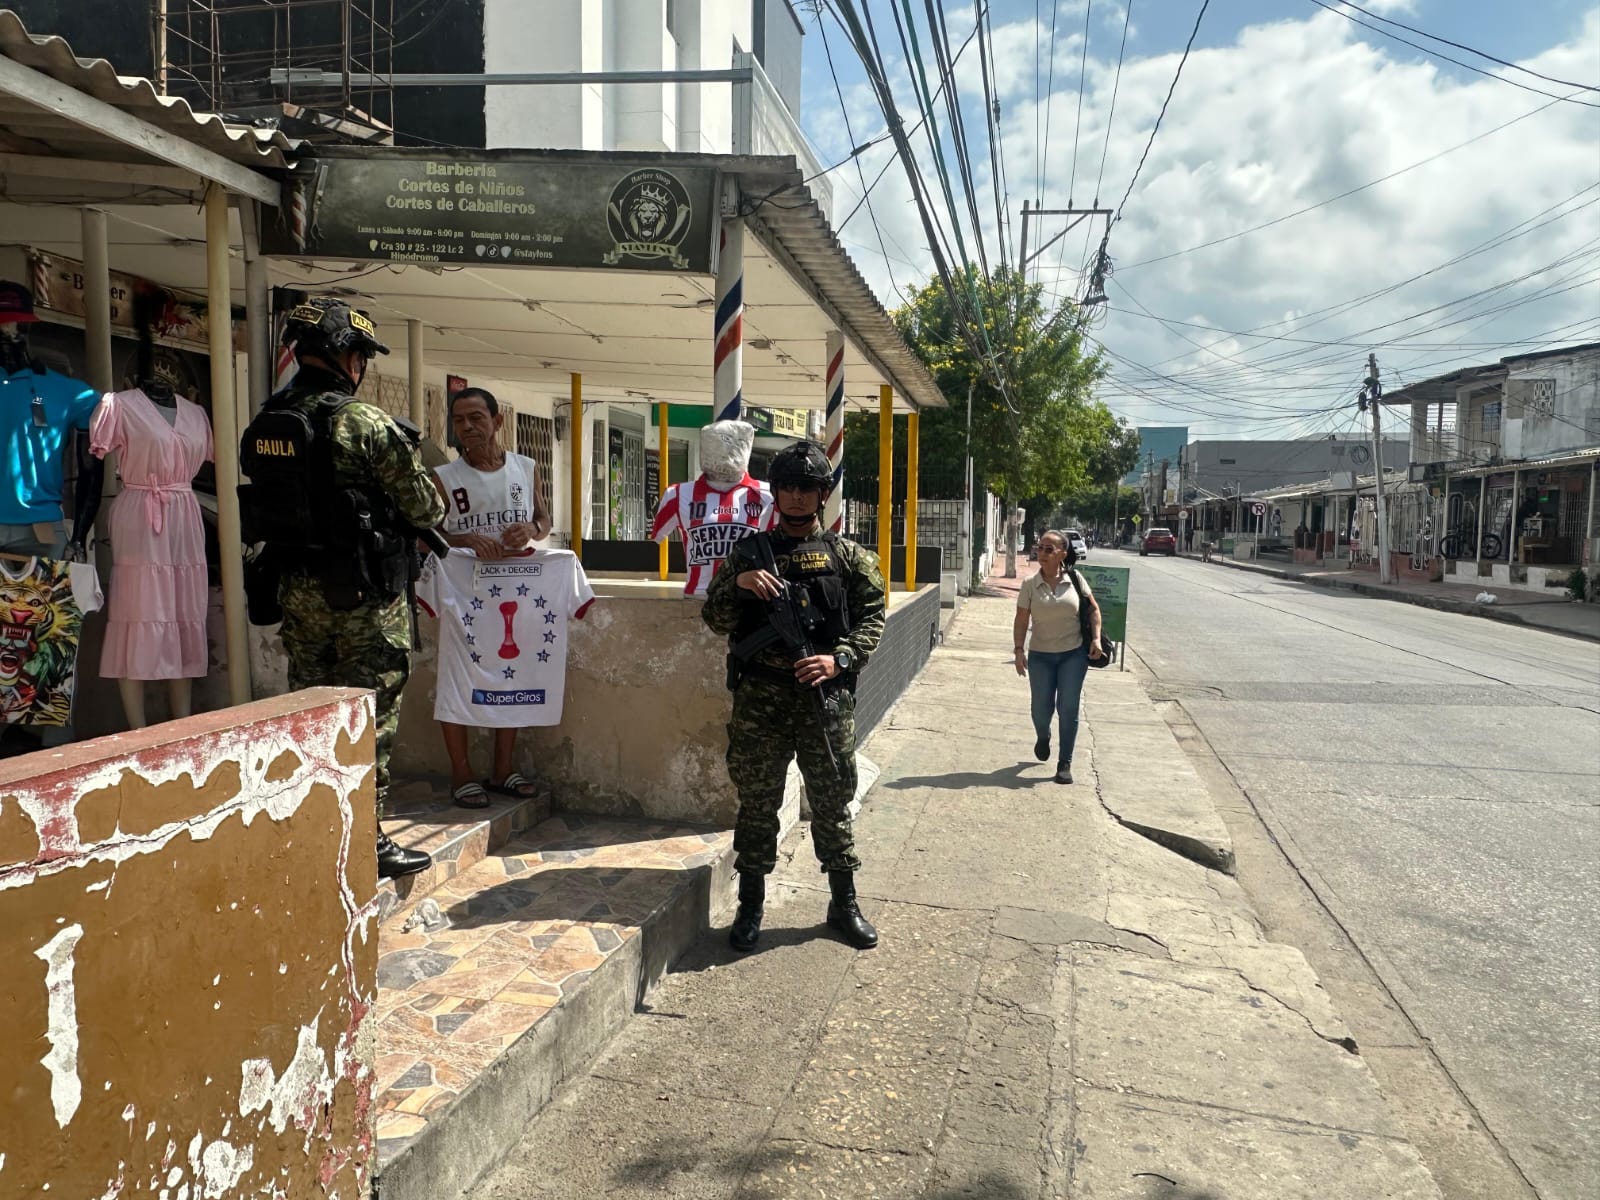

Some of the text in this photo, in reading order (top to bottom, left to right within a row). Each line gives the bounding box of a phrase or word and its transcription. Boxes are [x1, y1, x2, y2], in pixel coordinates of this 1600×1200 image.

[398, 178, 525, 197] Cortes de Niños
[385, 194, 536, 215] Cortes de Caballeros
[380, 241, 394, 251] Cra
[395, 243, 406, 251] 30
[415, 243, 425, 252] 25
[432, 244, 446, 253] 122
[458, 245, 464, 254] 2
[390, 252, 440, 262] Hipódromo
[73, 272, 126, 301] Ber
[256, 438, 296, 457] GAULA
[452, 487, 471, 515] 8
[688, 501, 707, 519] 10
[457, 509, 528, 531] HILFIGER
[695, 541, 732, 559] AGUI
[792, 552, 831, 563] GAULA
[480, 566, 501, 575] LACK
[508, 566, 540, 574] DECKER
[486, 692, 541, 704] SuperGiros
